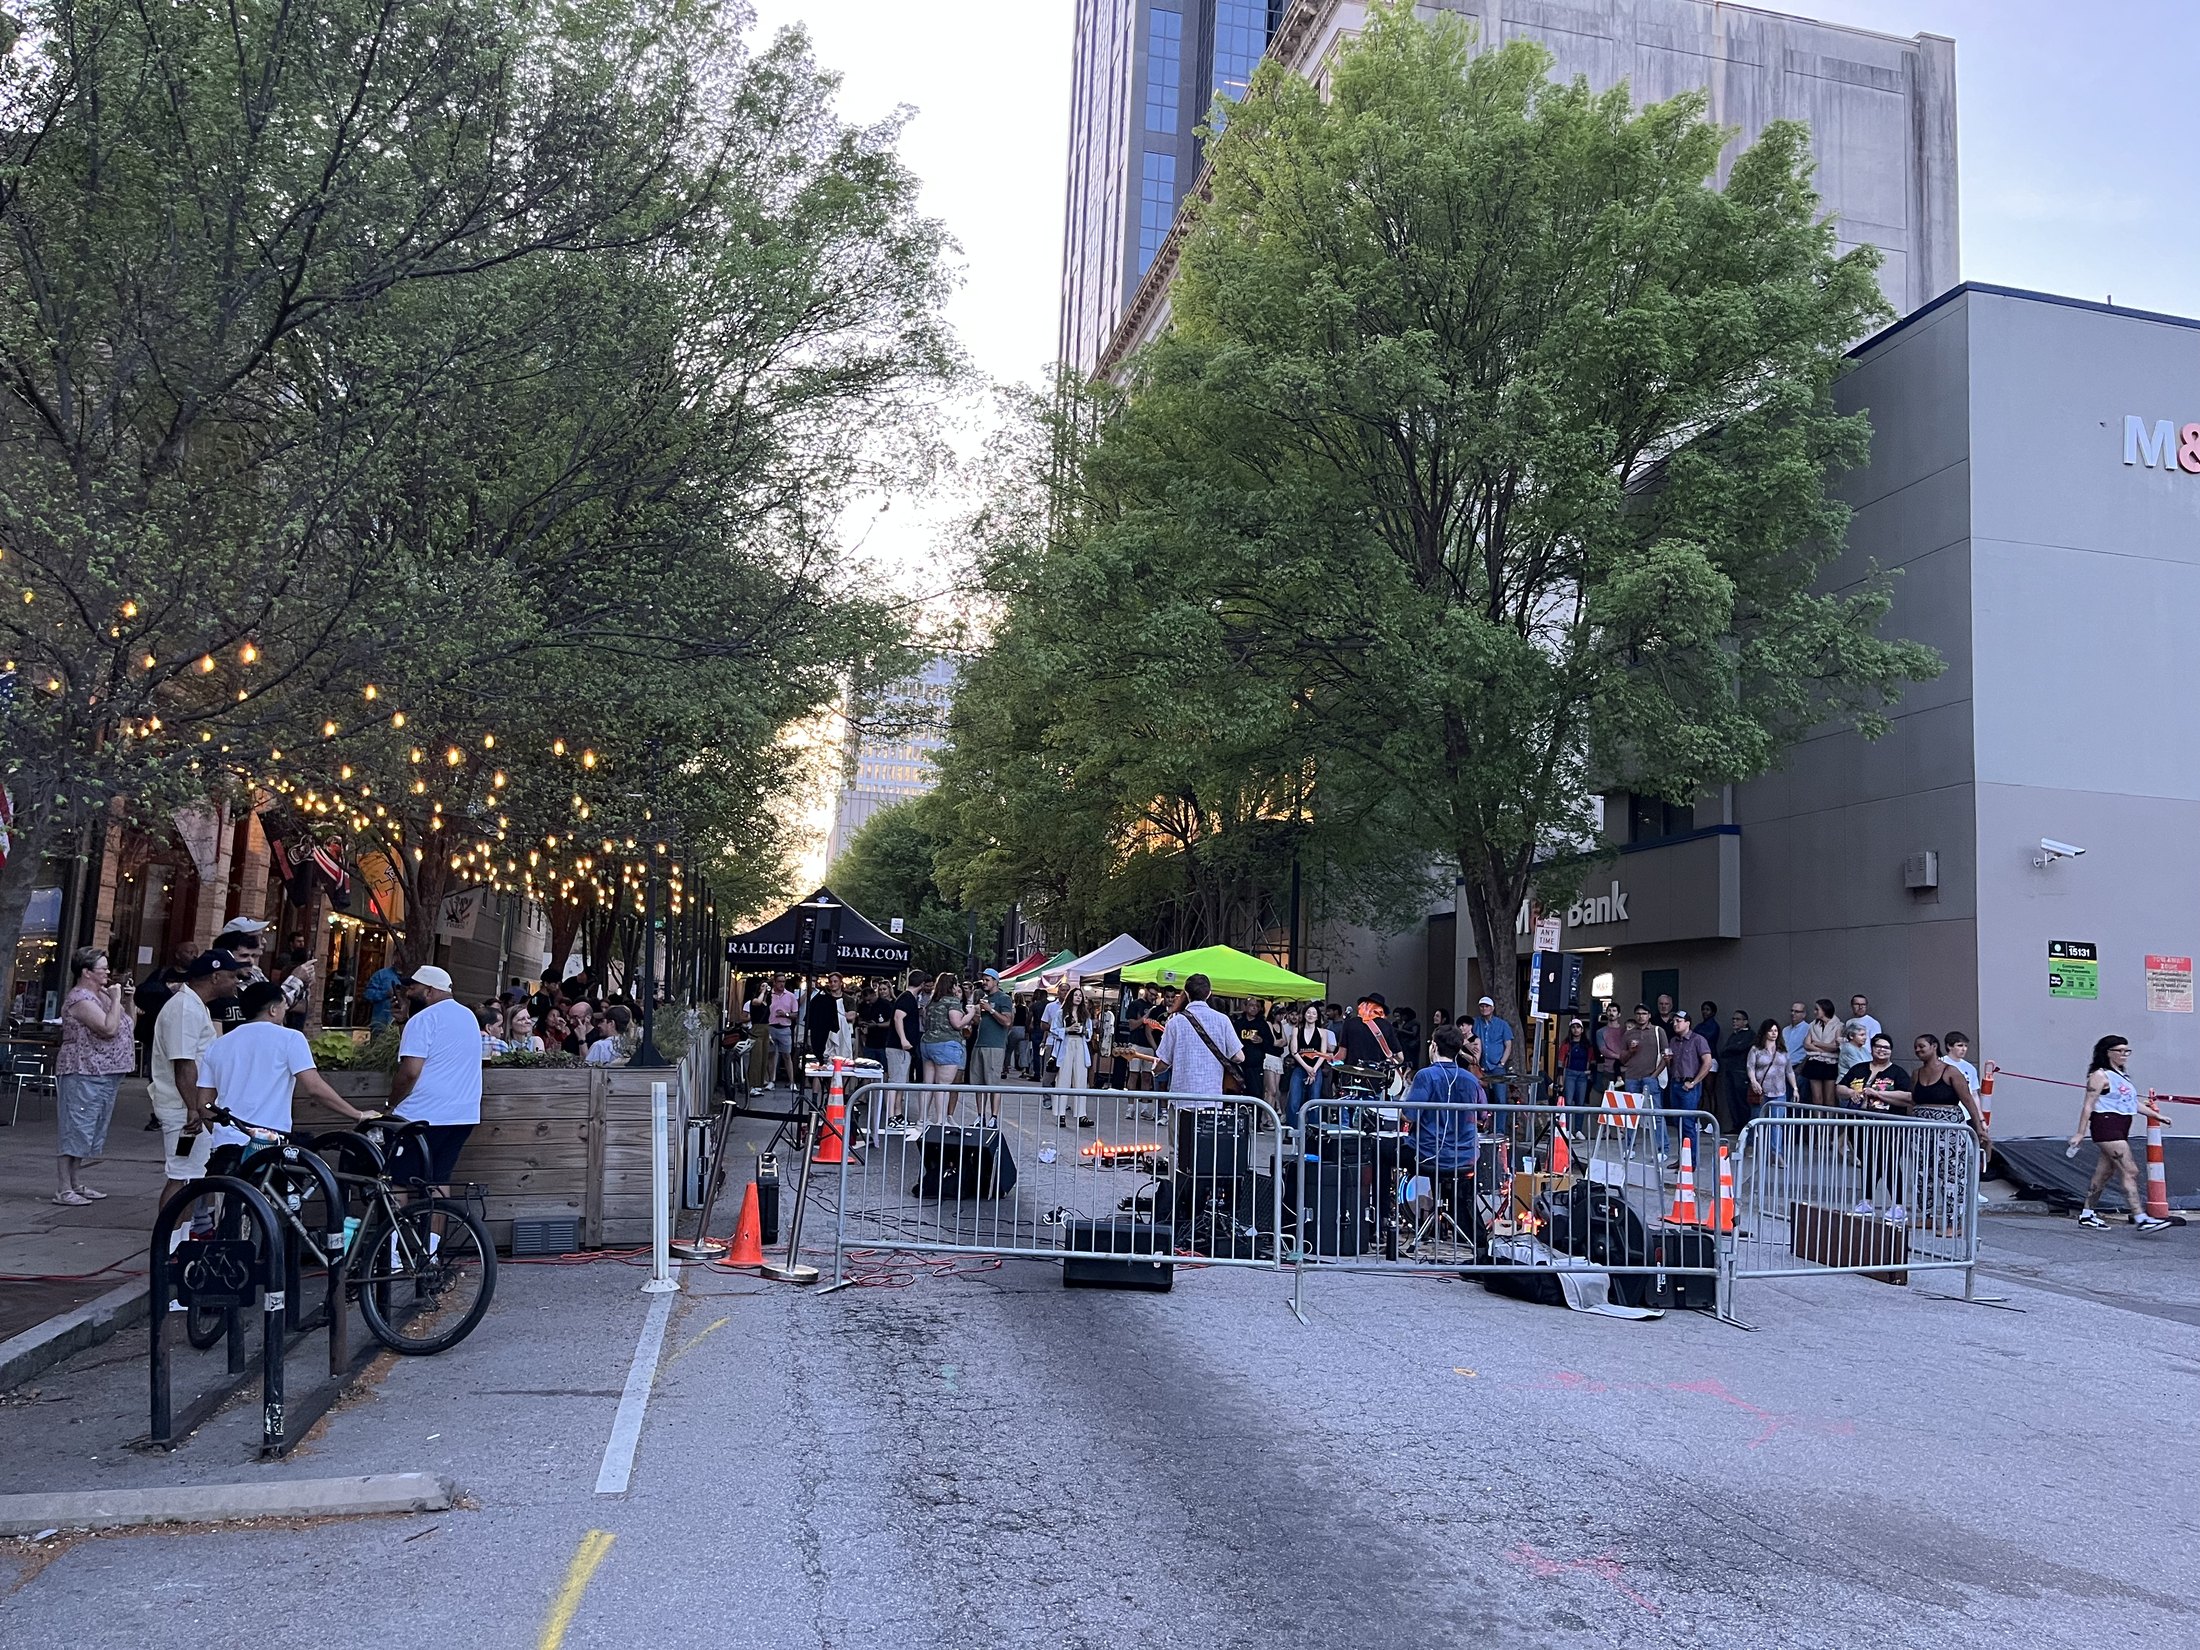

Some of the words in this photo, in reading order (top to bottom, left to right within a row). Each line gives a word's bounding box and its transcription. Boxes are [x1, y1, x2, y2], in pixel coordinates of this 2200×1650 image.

[1567, 880, 1629, 927] Bank
[1539, 936, 1554, 945] TIME
[2069, 947, 2090, 957] 15131
